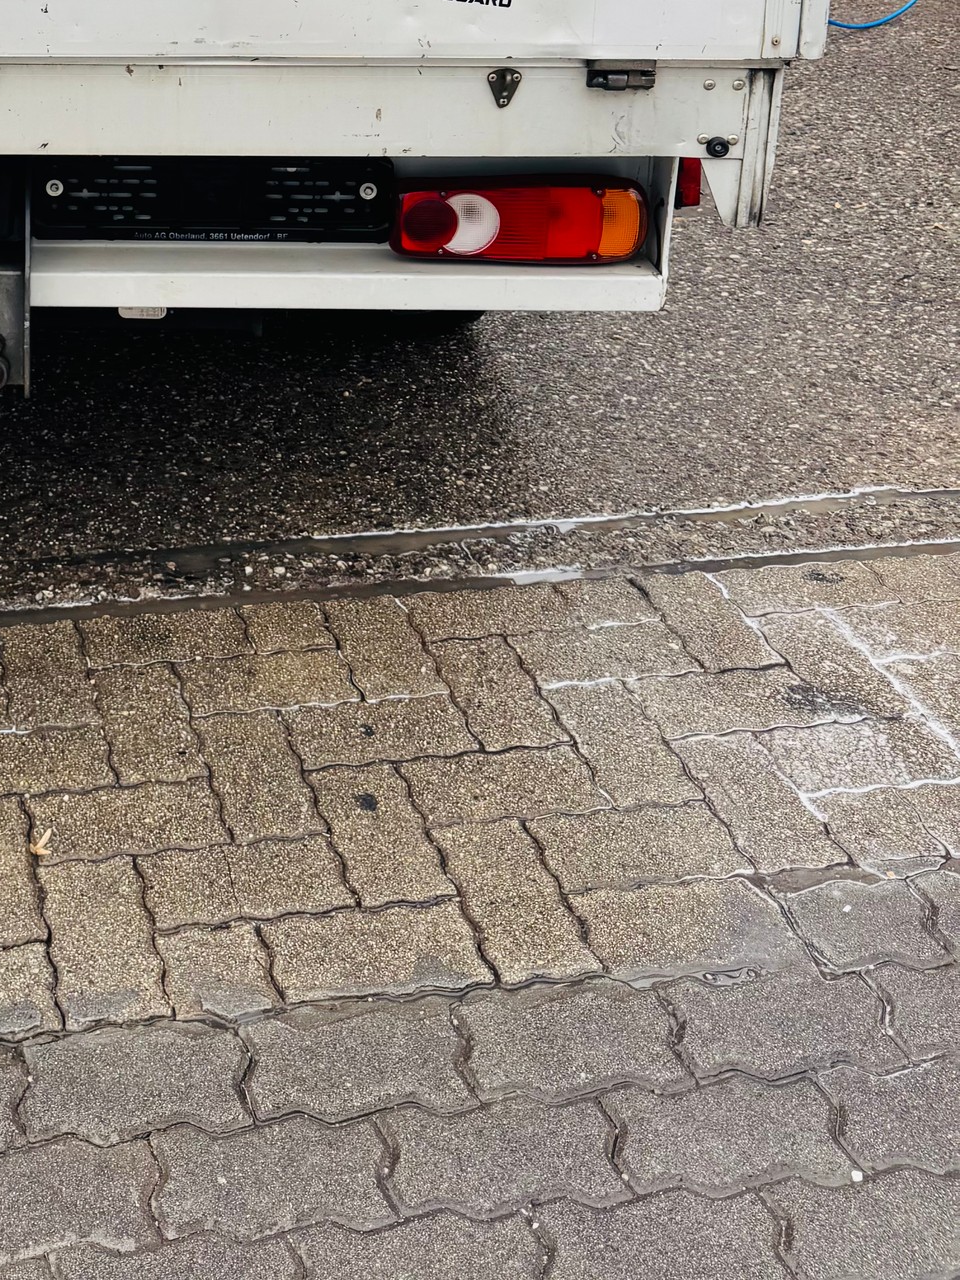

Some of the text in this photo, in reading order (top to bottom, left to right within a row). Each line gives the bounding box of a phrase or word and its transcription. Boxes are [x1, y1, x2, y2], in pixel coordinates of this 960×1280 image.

[134, 232, 152, 240] Auto
[154, 232, 166, 240] AG
[209, 232, 228, 240] 3661
[230, 232, 270, 240] Uetendorf
